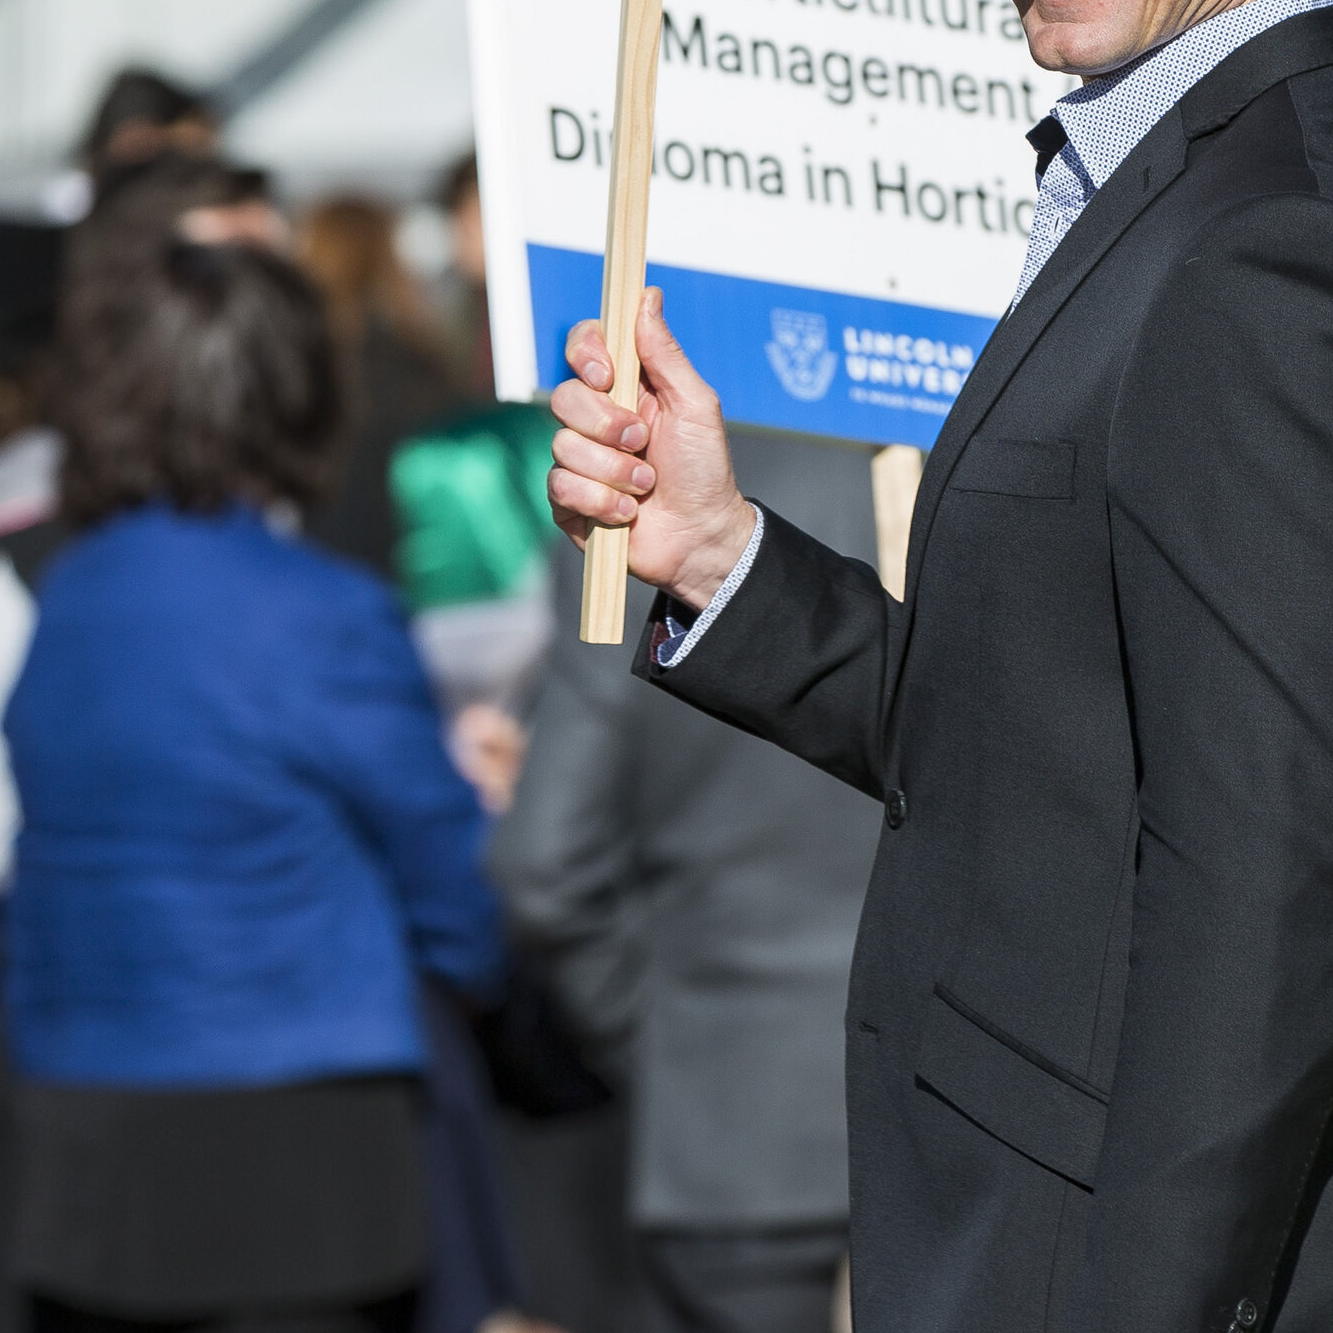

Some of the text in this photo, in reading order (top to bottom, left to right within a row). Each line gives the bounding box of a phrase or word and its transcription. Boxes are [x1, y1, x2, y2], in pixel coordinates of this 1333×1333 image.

[662, 9, 1036, 124] Management
[549, 106, 785, 196] Dioma
[801, 145, 854, 209] in
[843, 326, 973, 369] LINCOLN
[845, 353, 970, 397] UNIVER
